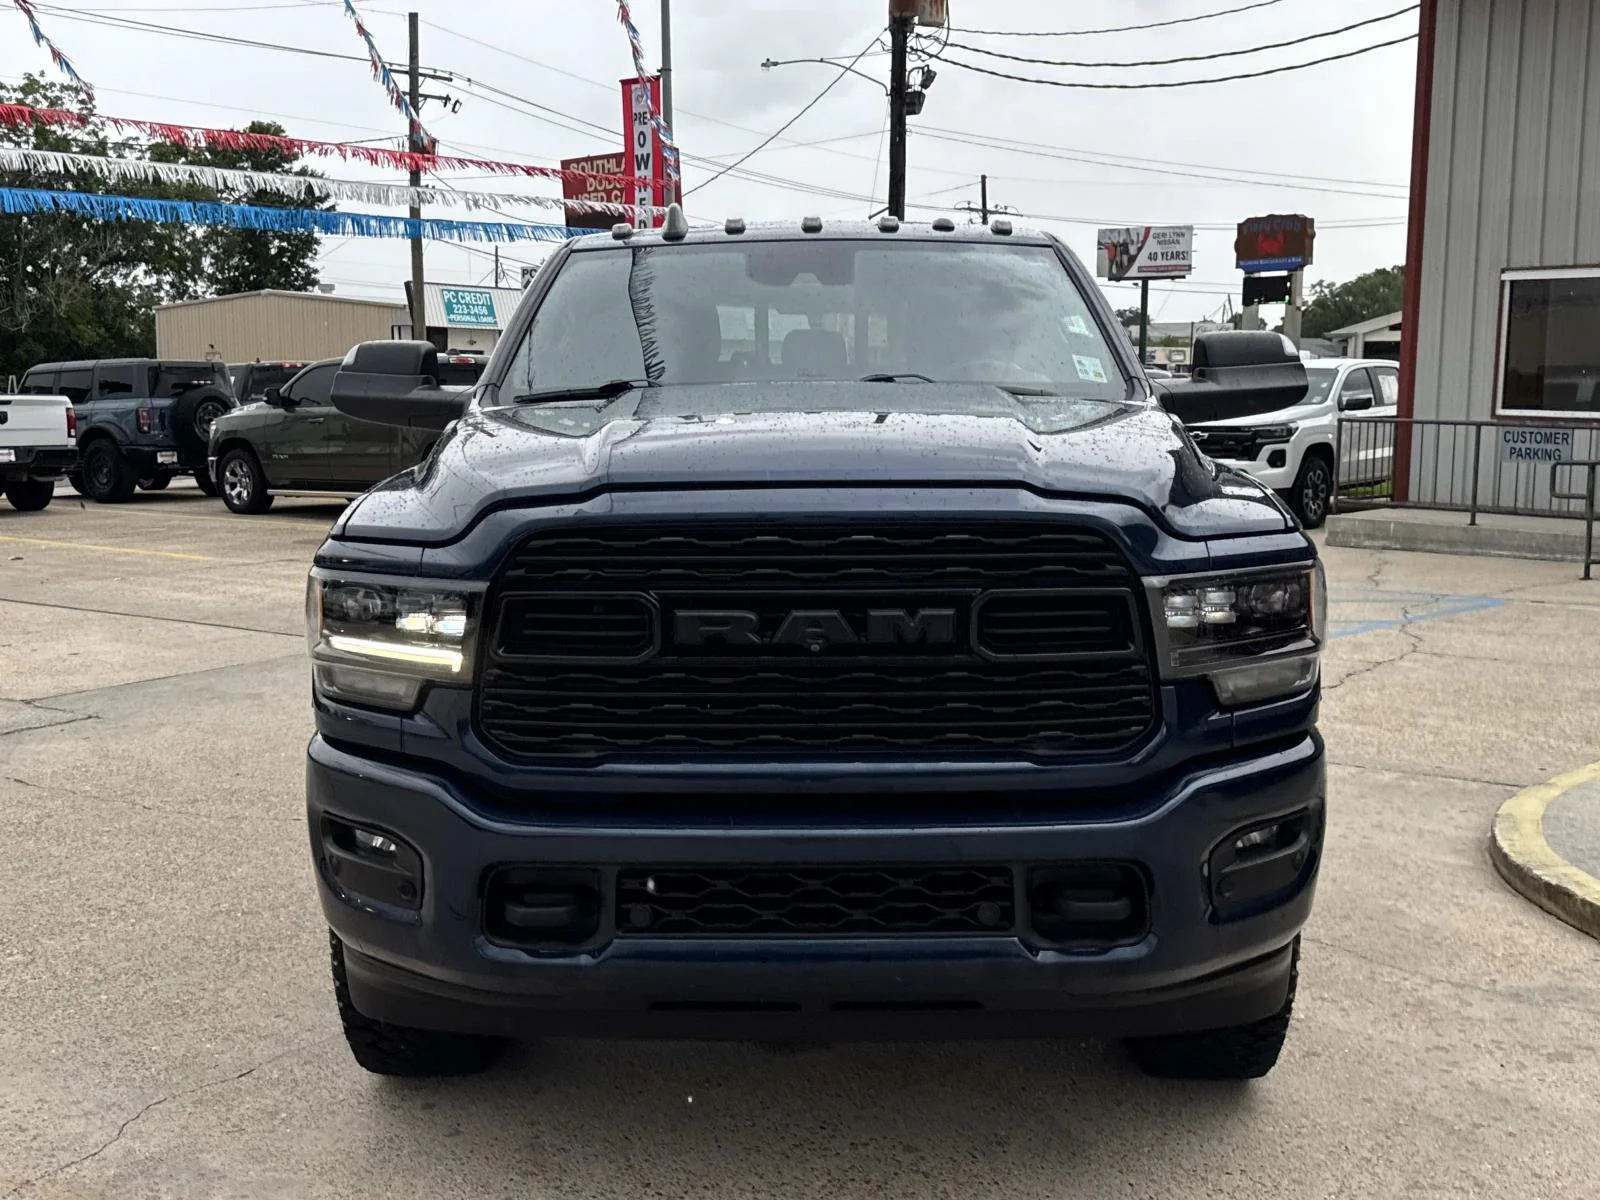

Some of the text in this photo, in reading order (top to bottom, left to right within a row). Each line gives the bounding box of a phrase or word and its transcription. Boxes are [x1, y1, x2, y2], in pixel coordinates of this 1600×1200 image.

[1147, 249, 1189, 261] 40 YEARS!
[443, 290, 490, 305] PC CREDIT
[1503, 430, 1570, 446] CUSTOMER
[1509, 446, 1562, 461] PARKING
[674, 608, 956, 645] RAM
